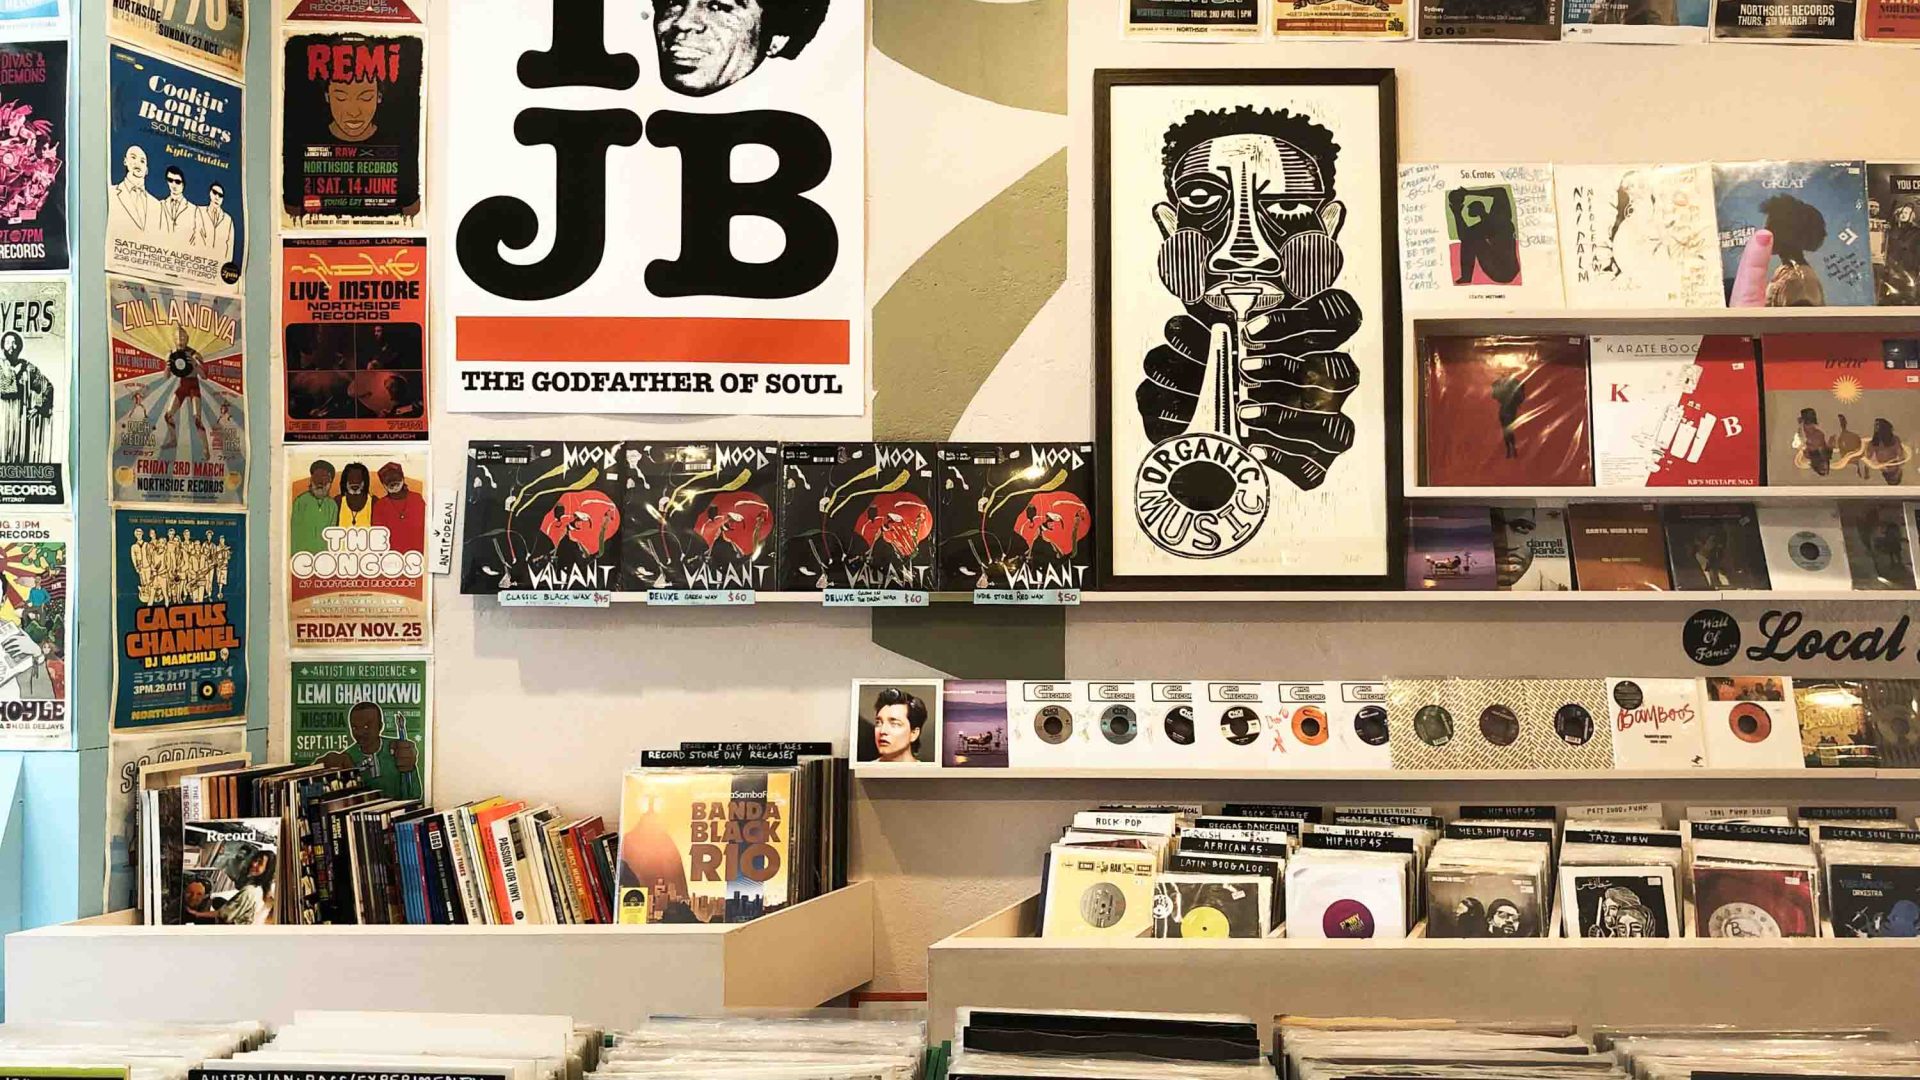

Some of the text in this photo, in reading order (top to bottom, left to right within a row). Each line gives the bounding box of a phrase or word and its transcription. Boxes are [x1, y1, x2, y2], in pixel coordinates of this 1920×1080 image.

[309, 4, 366, 12] RECORDS
[1221, 10, 1236, 18] APRIL
[1740, 5, 1834, 16] NORTHSIDE RECORDS
[1779, 16, 1835, 26] MARCH 6PM
[158, 24, 191, 44] SUNDAY
[1, 53, 33, 69] DIVAS
[1, 68, 46, 84] DEMONS
[164, 99, 192, 117] on
[138, 100, 232, 143] Burners
[151, 122, 180, 136] SOUL
[304, 161, 398, 173] NORTHSIDE RECORDS
[348, 177, 398, 194] 14 JUNE
[1896, 180, 1911, 189] YOU
[456, 107, 839, 301] JB
[114, 238, 219, 267] SATURDAY AUGUST 22
[114, 246, 218, 275] NORTHSIDE RECORDS
[131, 257, 175, 271] GERTRUDE
[187, 268, 217, 280] FITZROY
[289, 281, 330, 300] LIVE
[308, 302, 400, 311] NORTHSIDE
[115, 298, 237, 346] ZILLANOVA
[312, 312, 390, 320] RECORDS
[1606, 344, 1656, 353] KARATE
[462, 371, 843, 394] THE GODFATHER OF SOUL
[1610, 383, 1630, 403] K
[1721, 415, 1743, 438] B
[137, 460, 225, 477] FRIDAY 3RD MARCH
[1144, 437, 1261, 486] ORGANIC
[137, 478, 225, 493] NORTHSIDE RECORDS
[1138, 487, 1264, 551] MUSIC
[0, 531, 50, 539] RECORDS
[322, 526, 390, 552] THE
[1526, 538, 1562, 548] darrell
[1530, 546, 1565, 555] banks
[291, 551, 424, 578] CONGOS
[506, 592, 538, 601] CLASSIC
[544, 592, 570, 601] BLACK
[649, 592, 679, 601] DELUXE
[825, 594, 855, 602] DELUXE
[993, 592, 1077, 602] STORE $50
[136, 603, 227, 631] CACTUS
[296, 622, 421, 637] FRIDAY NOV. 25
[1703, 630, 1720, 644] Of
[1746, 610, 1910, 662] Local
[126, 625, 239, 658] CHANNEL
[145, 651, 216, 668] DJ MANCHILD
[313, 665, 407, 677] ARTIST IN RESIDENCE
[297, 683, 422, 704] LEMI GHARIOKWU
[302, 712, 346, 728] NIGERIA
[648, 751, 793, 760] RECORD STORE DAY RELEASES
[691, 802, 781, 820] BANDA
[447, 814, 458, 838] MISTER
[1096, 817, 1142, 827] ROCK POP
[207, 829, 257, 842] Record
[690, 821, 781, 843] BLACK
[1588, 833, 1648, 843] JAZZ NEW
[1834, 829, 1892, 839] LOCAL SOUL
[1204, 841, 1262, 854] AFRICAN 45
[1326, 836, 1382, 847] HIP HOP 45
[498, 837, 521, 903] PASSION FOR VINYL
[689, 843, 781, 883] RIO
[1180, 859, 1263, 873] LATIN BOOGALOO
[1852, 889, 1883, 897] ORKESTRA
